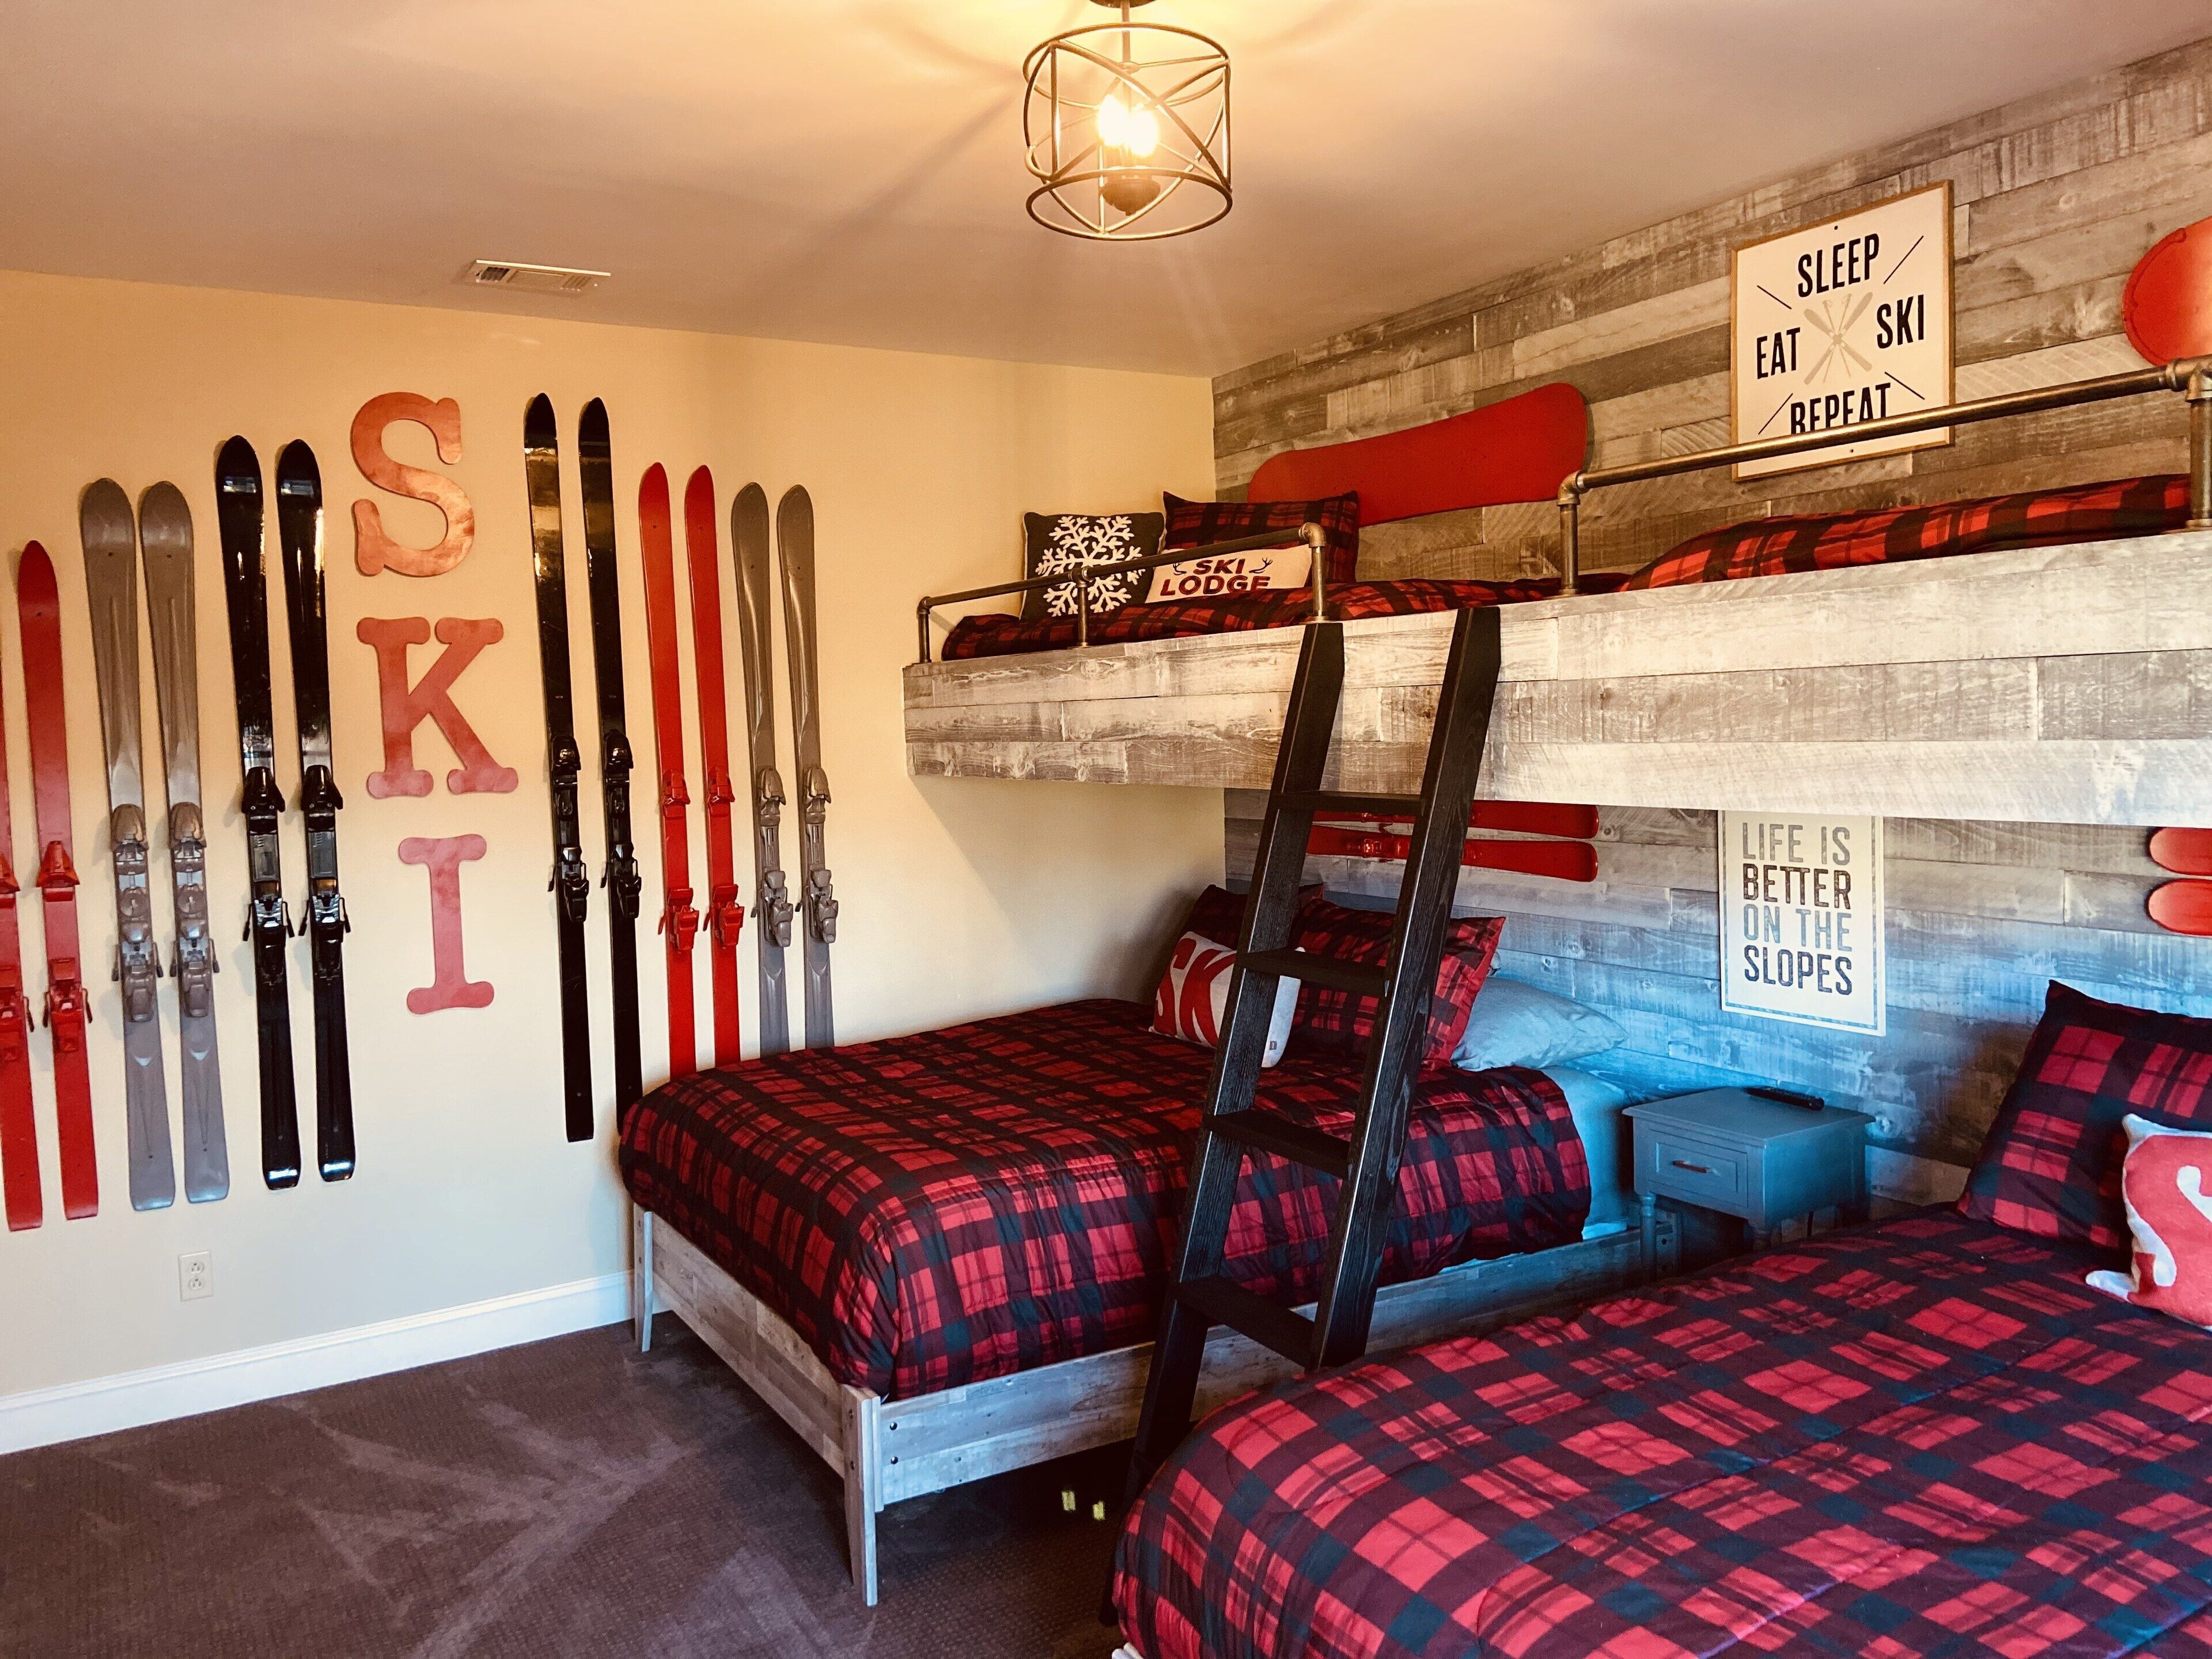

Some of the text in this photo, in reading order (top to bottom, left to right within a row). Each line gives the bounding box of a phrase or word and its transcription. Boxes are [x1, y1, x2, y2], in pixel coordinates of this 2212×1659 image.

[1797, 233, 1880, 298] SLEEP
[1876, 294, 1925, 349] SKI
[1756, 327, 1801, 379] EAT
[1790, 382, 1891, 435] REPEAT
[1160, 575, 1271, 596] LODGE
[1193, 558, 1245, 575] SKI
[349, 392, 519, 1015] SKI
[1742, 822, 1851, 866] LIFE IS
[1743, 863, 1851, 910] BETTER
[1743, 903, 1853, 952] ON THE
[1744, 944, 1853, 996] SLOPES
